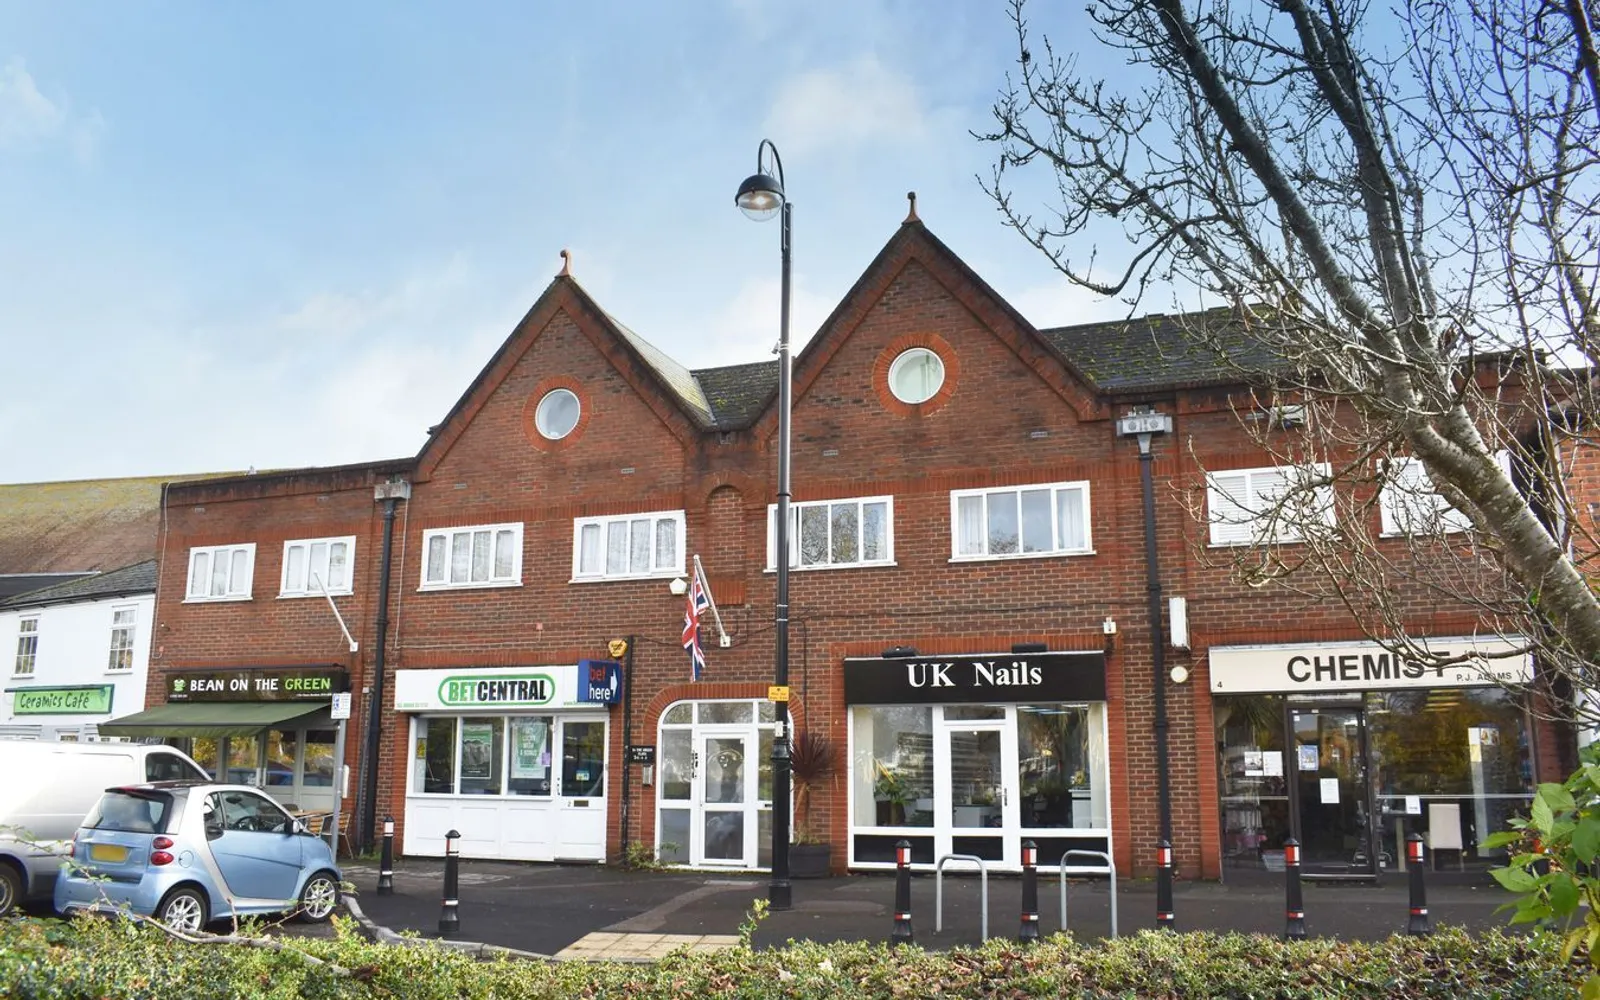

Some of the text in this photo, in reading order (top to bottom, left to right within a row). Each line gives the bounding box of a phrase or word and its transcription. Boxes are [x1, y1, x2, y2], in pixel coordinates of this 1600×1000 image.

[589, 664, 606, 681] bet
[906, 661, 1042, 687] UK Nails
[190, 677, 331, 691] BEAN ON THE GREEN
[447, 679, 547, 702] BETCENTRAL
[589, 682, 611, 700] here
[20, 691, 90, 709] Ceramics Café
